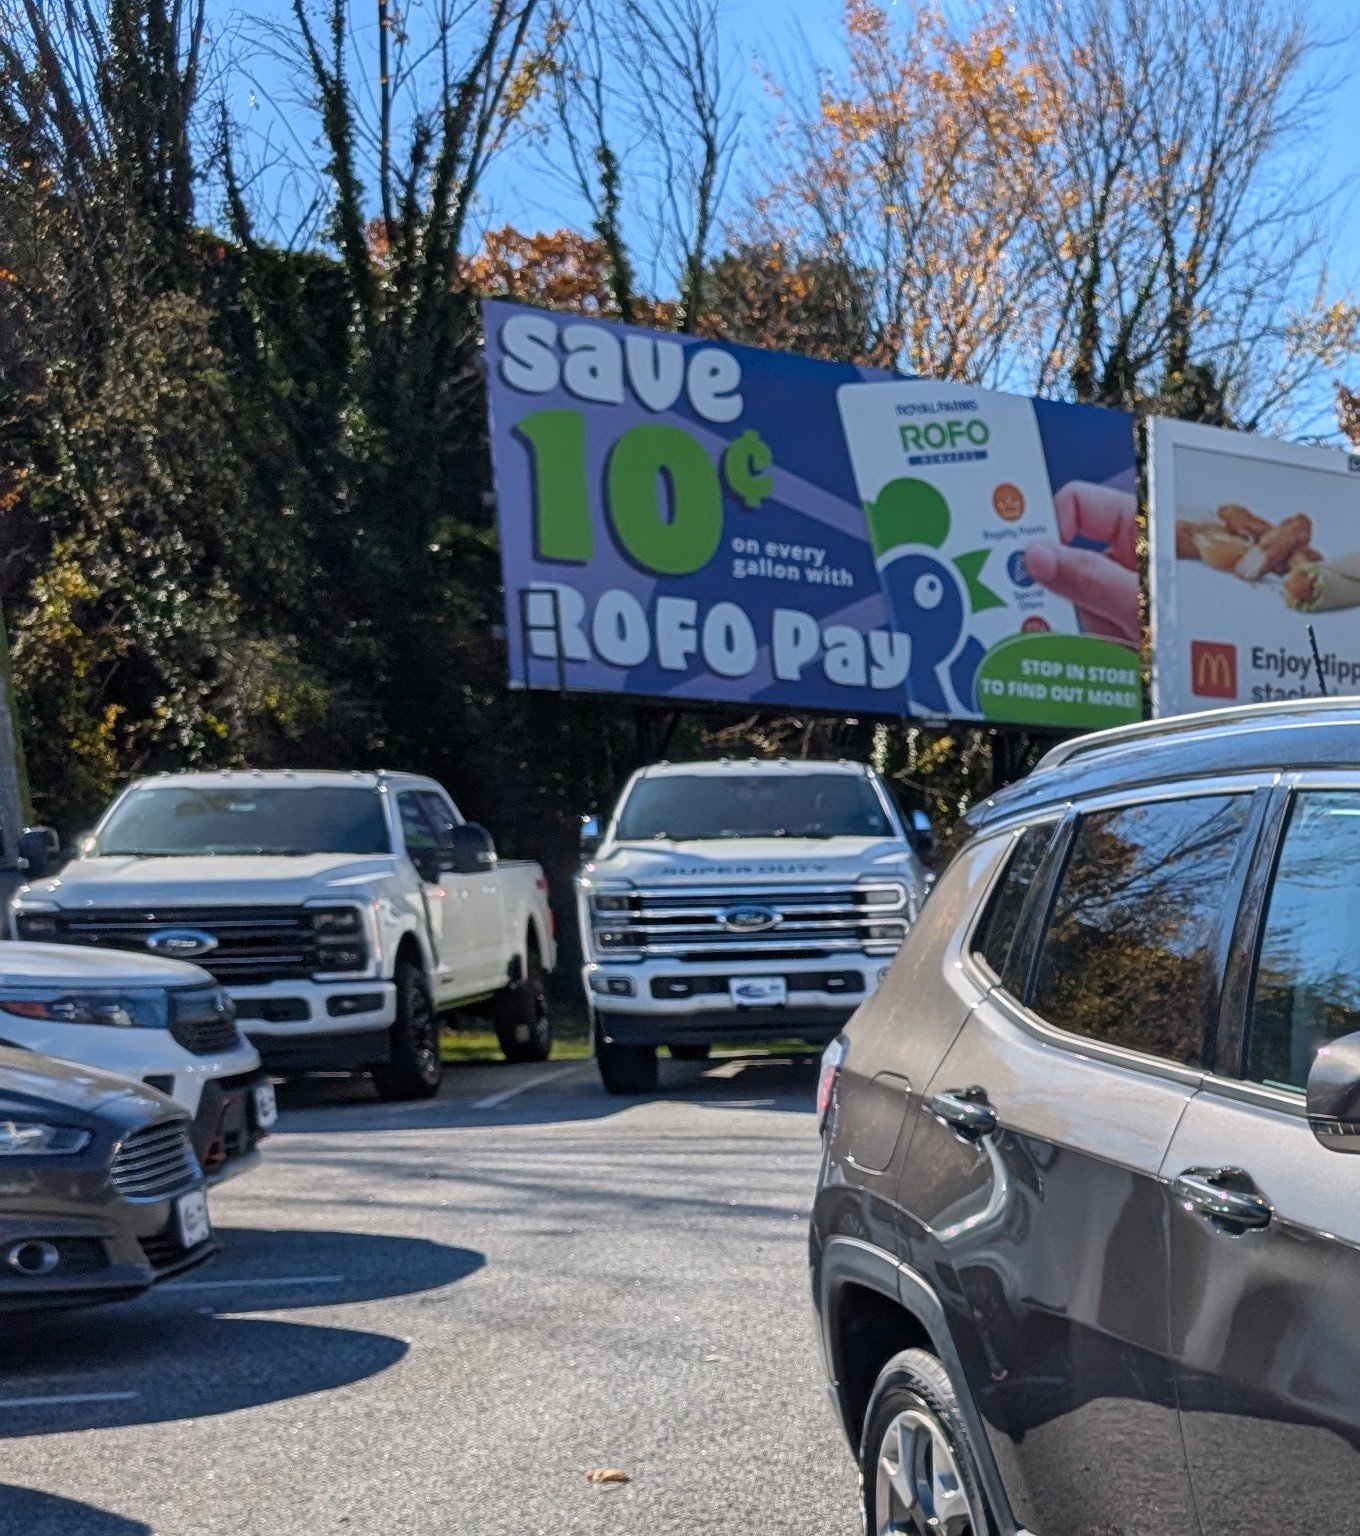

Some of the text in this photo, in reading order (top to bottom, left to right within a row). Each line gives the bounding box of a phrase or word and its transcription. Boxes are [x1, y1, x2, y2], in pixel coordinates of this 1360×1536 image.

[899, 419, 990, 452] ROFO
[732, 537, 826, 567] on every
[733, 557, 853, 587] gallon with
[527, 582, 912, 689] ROFO Pay
[1021, 658, 1137, 685] STOP IN STORE
[1252, 646, 1311, 679] Enjoy
[981, 678, 1004, 695] TO
[1008, 680, 1047, 699] FIND
[1050, 685, 1083, 702] OUT
